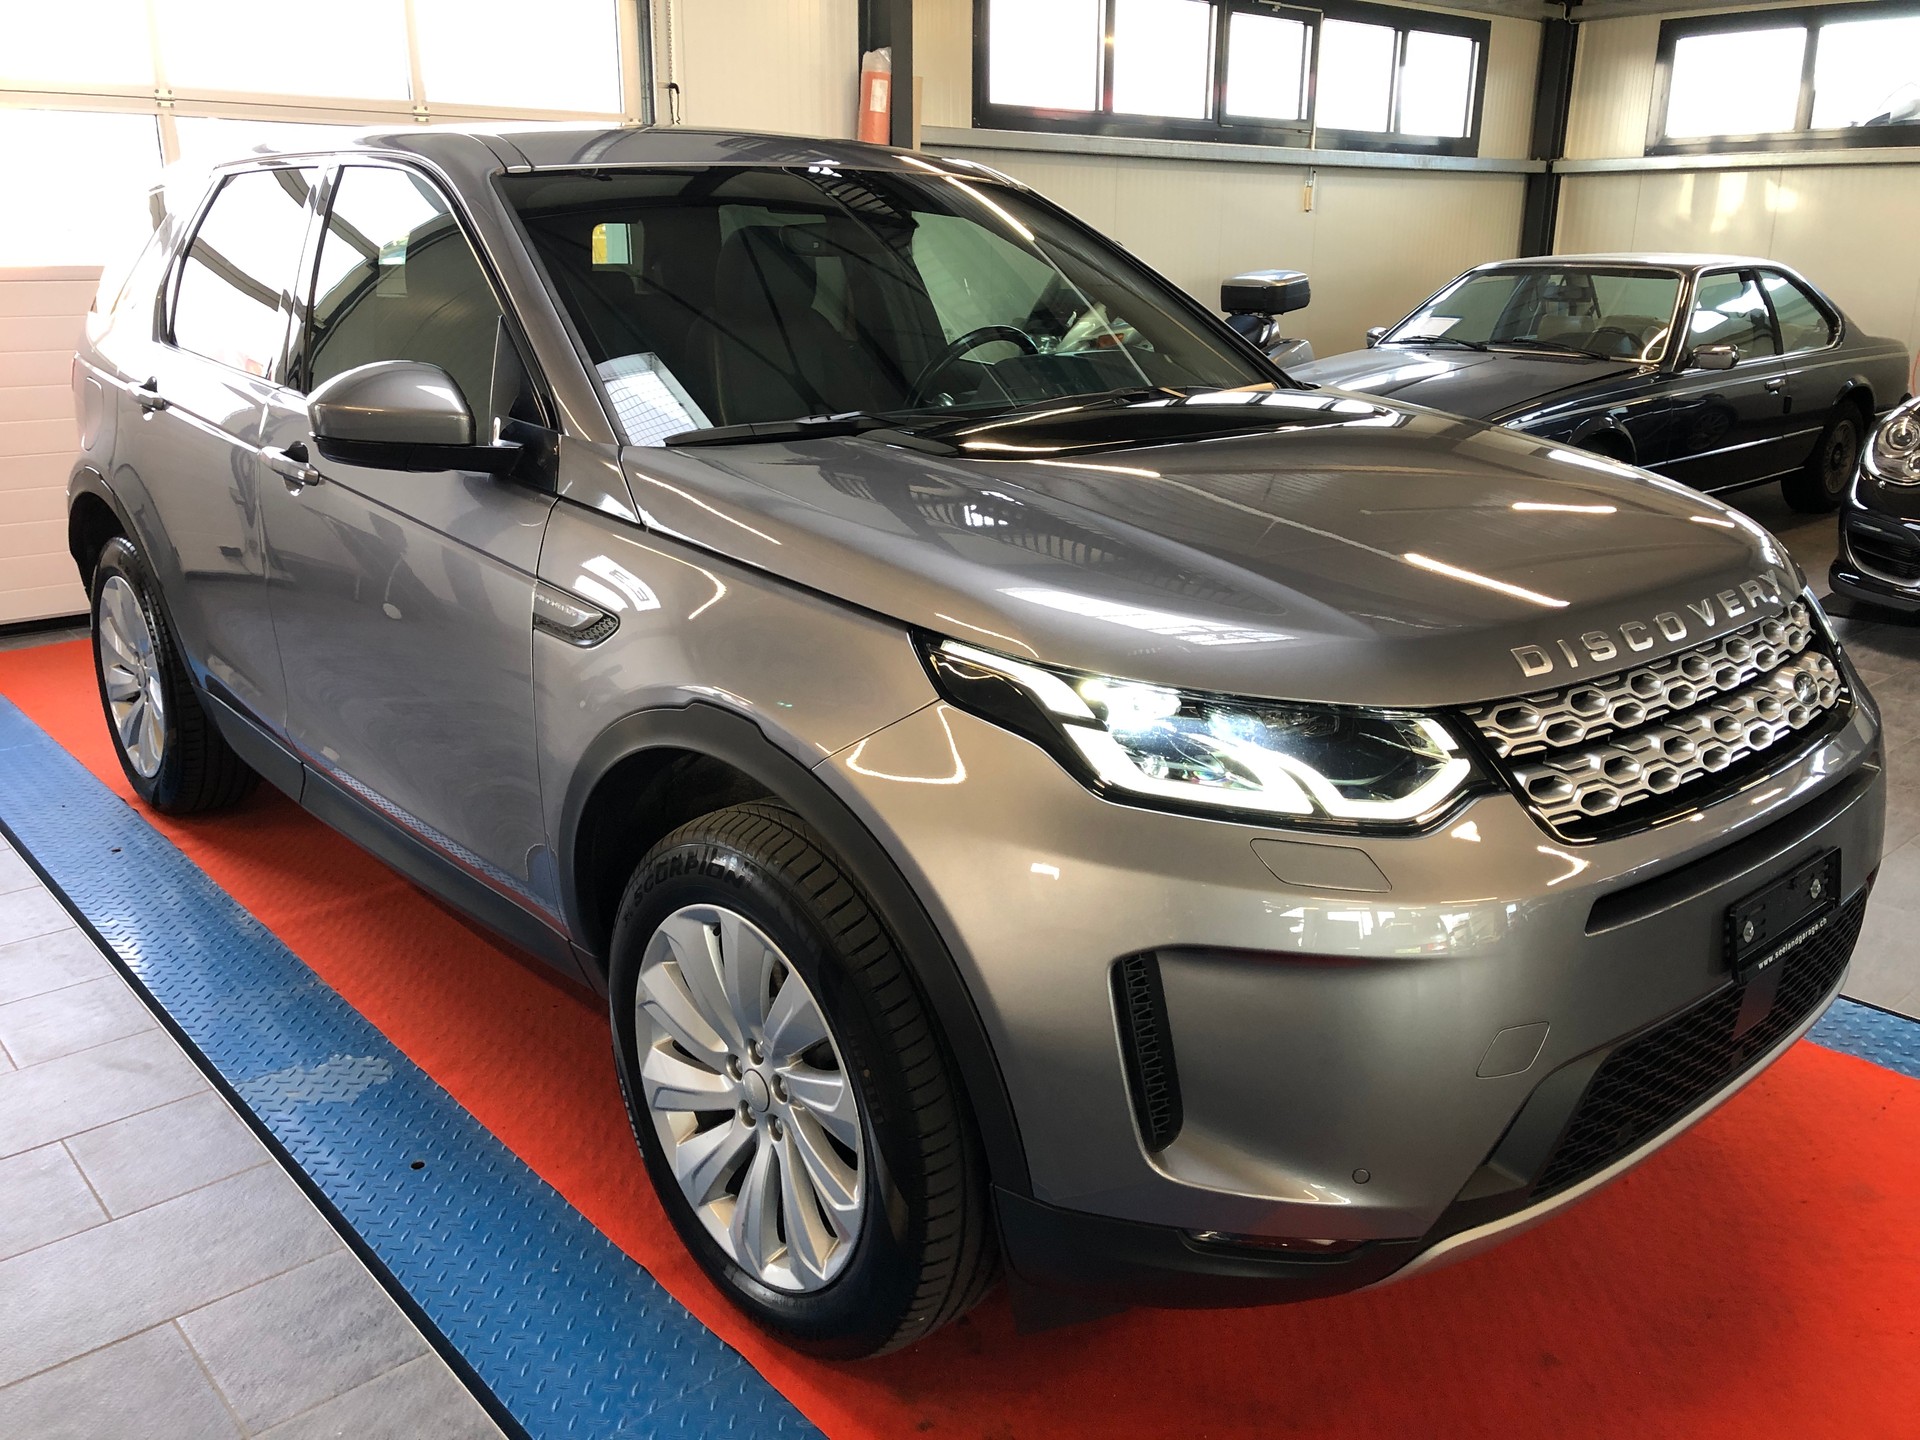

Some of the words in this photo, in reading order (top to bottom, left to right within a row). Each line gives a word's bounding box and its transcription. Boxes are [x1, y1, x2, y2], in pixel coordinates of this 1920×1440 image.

[1510, 569, 1782, 677] DISCOVERY
[634, 852, 746, 907] SCORPION
[1758, 917, 1827, 970] www.seelandgarage.ch
